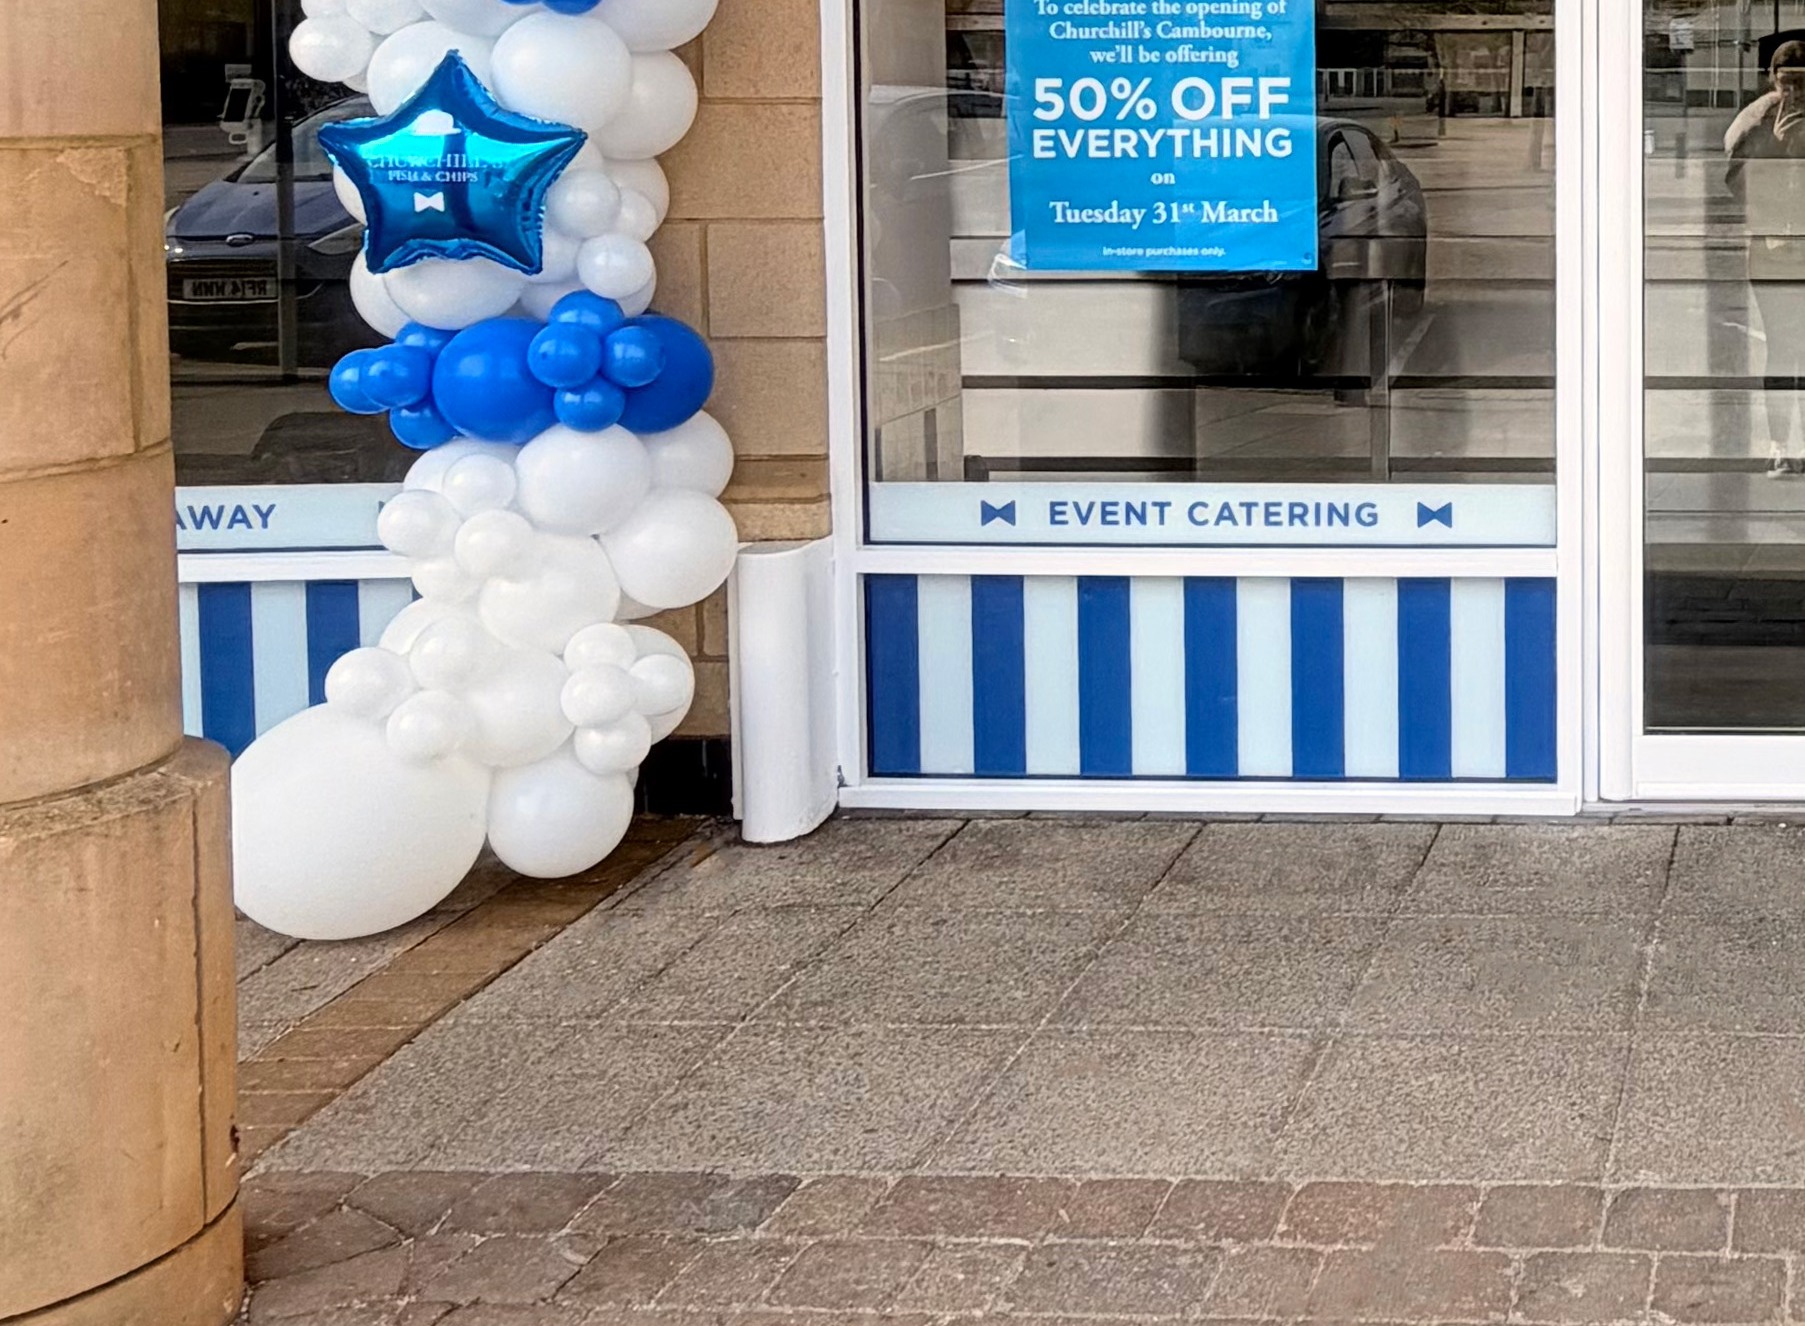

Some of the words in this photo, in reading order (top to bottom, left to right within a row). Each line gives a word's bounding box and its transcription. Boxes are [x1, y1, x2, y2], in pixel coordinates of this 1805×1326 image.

[1049, 21, 1151, 40] Churchill's
[1156, 21, 1272, 41] Cambourne,
[1089, 45, 1132, 63] we'll
[1138, 45, 1160, 63] be
[1165, 44, 1239, 68] offering
[1033, 76, 1157, 121] 50%
[1171, 76, 1291, 121] OFF
[1032, 127, 1293, 159] EVERYTHING
[421, 171, 432, 181] &
[435, 171, 478, 182] CHIPS
[1150, 172, 1175, 185] on
[1049, 200, 1147, 230] Tuesday
[1152, 201, 1195, 225] 31st
[1201, 200, 1279, 224] March
[1146, 246, 1199, 258] purchases
[1201, 246, 1227, 258] only.
[1049, 501, 1172, 526] EVENT
[1187, 501, 1379, 527] CATERING
